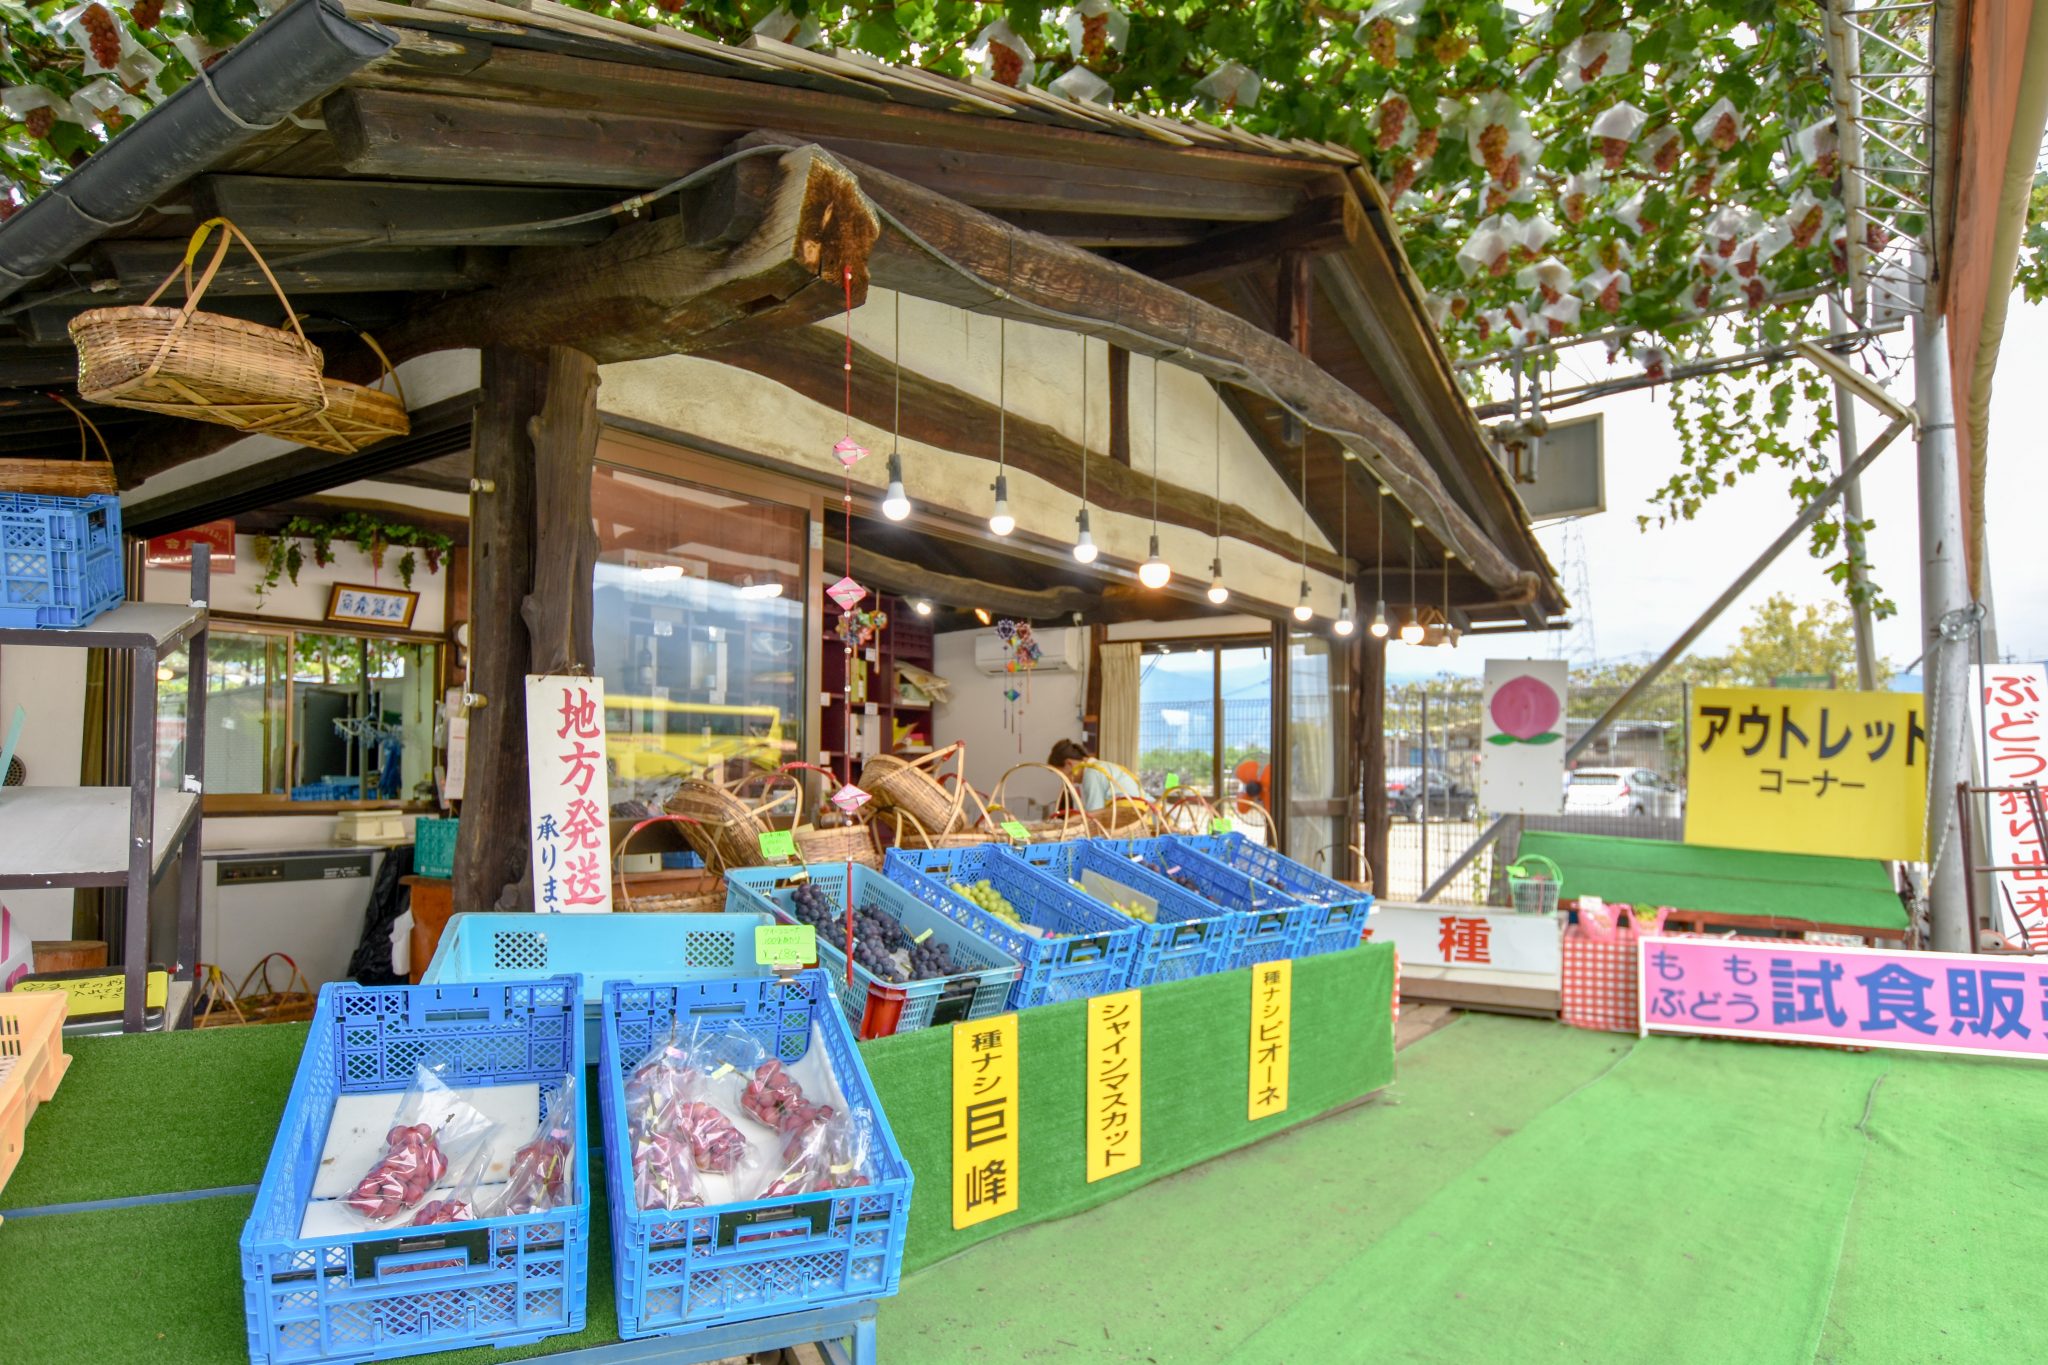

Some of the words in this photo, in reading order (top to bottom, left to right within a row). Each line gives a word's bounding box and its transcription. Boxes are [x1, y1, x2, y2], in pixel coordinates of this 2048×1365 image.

[1699, 704, 1926, 767] アウトレット
[1760, 768, 1866, 798] コーナー
[556, 687, 606, 905] 地方発送
[1256, 970, 1284, 1106] 種ナシピオーネ
[1651, 988, 1760, 1025] ぶどう
[1769, 956, 2048, 1041] 試食販
[965, 1029, 1008, 1212] 種ナシ巨峰
[1099, 1004, 1131, 1168] シャインマスカット
